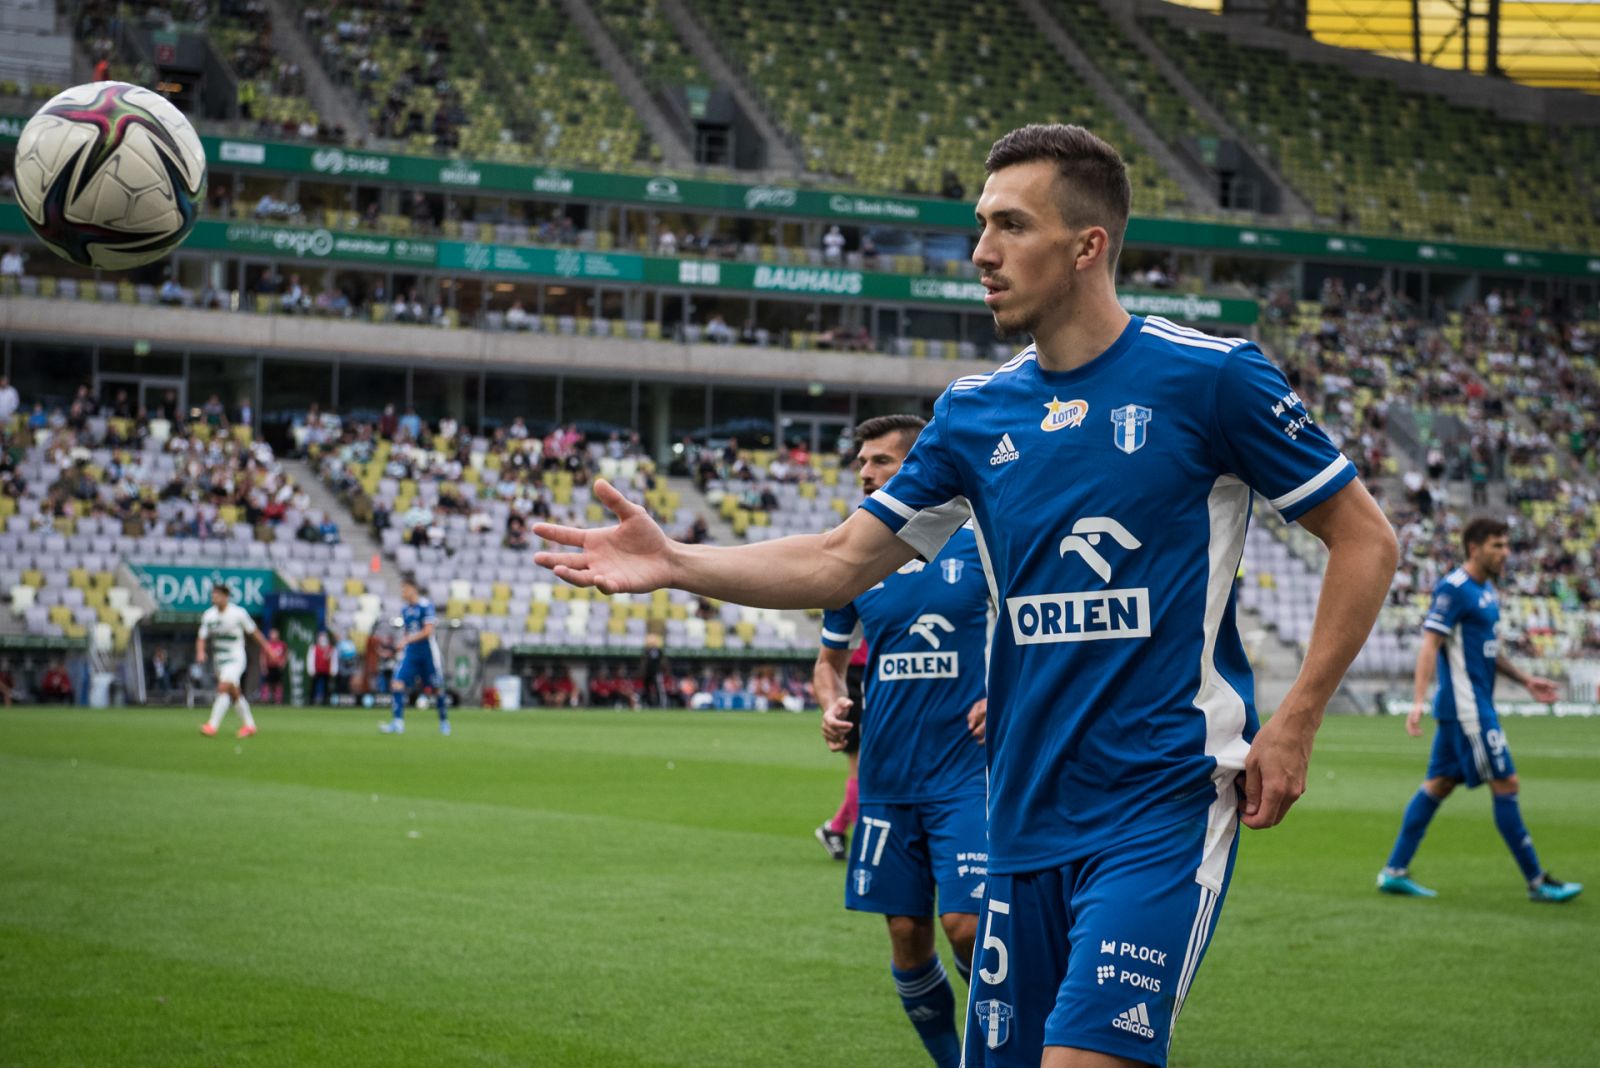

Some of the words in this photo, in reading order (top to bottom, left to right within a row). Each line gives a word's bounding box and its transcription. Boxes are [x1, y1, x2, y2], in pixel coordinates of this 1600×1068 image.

[754, 266, 863, 294] BAUHAUS
[1052, 406, 1079, 425] LOTTO
[990, 450, 1020, 466] adidas
[1017, 596, 1139, 637] ORLEN
[883, 655, 952, 675] ORLEN
[862, 816, 891, 867] 17
[978, 898, 1010, 985] 5
[1119, 941, 1168, 967] PŁOCK
[1119, 970, 1161, 993] POKIS
[1112, 1015, 1155, 1039] adidas
